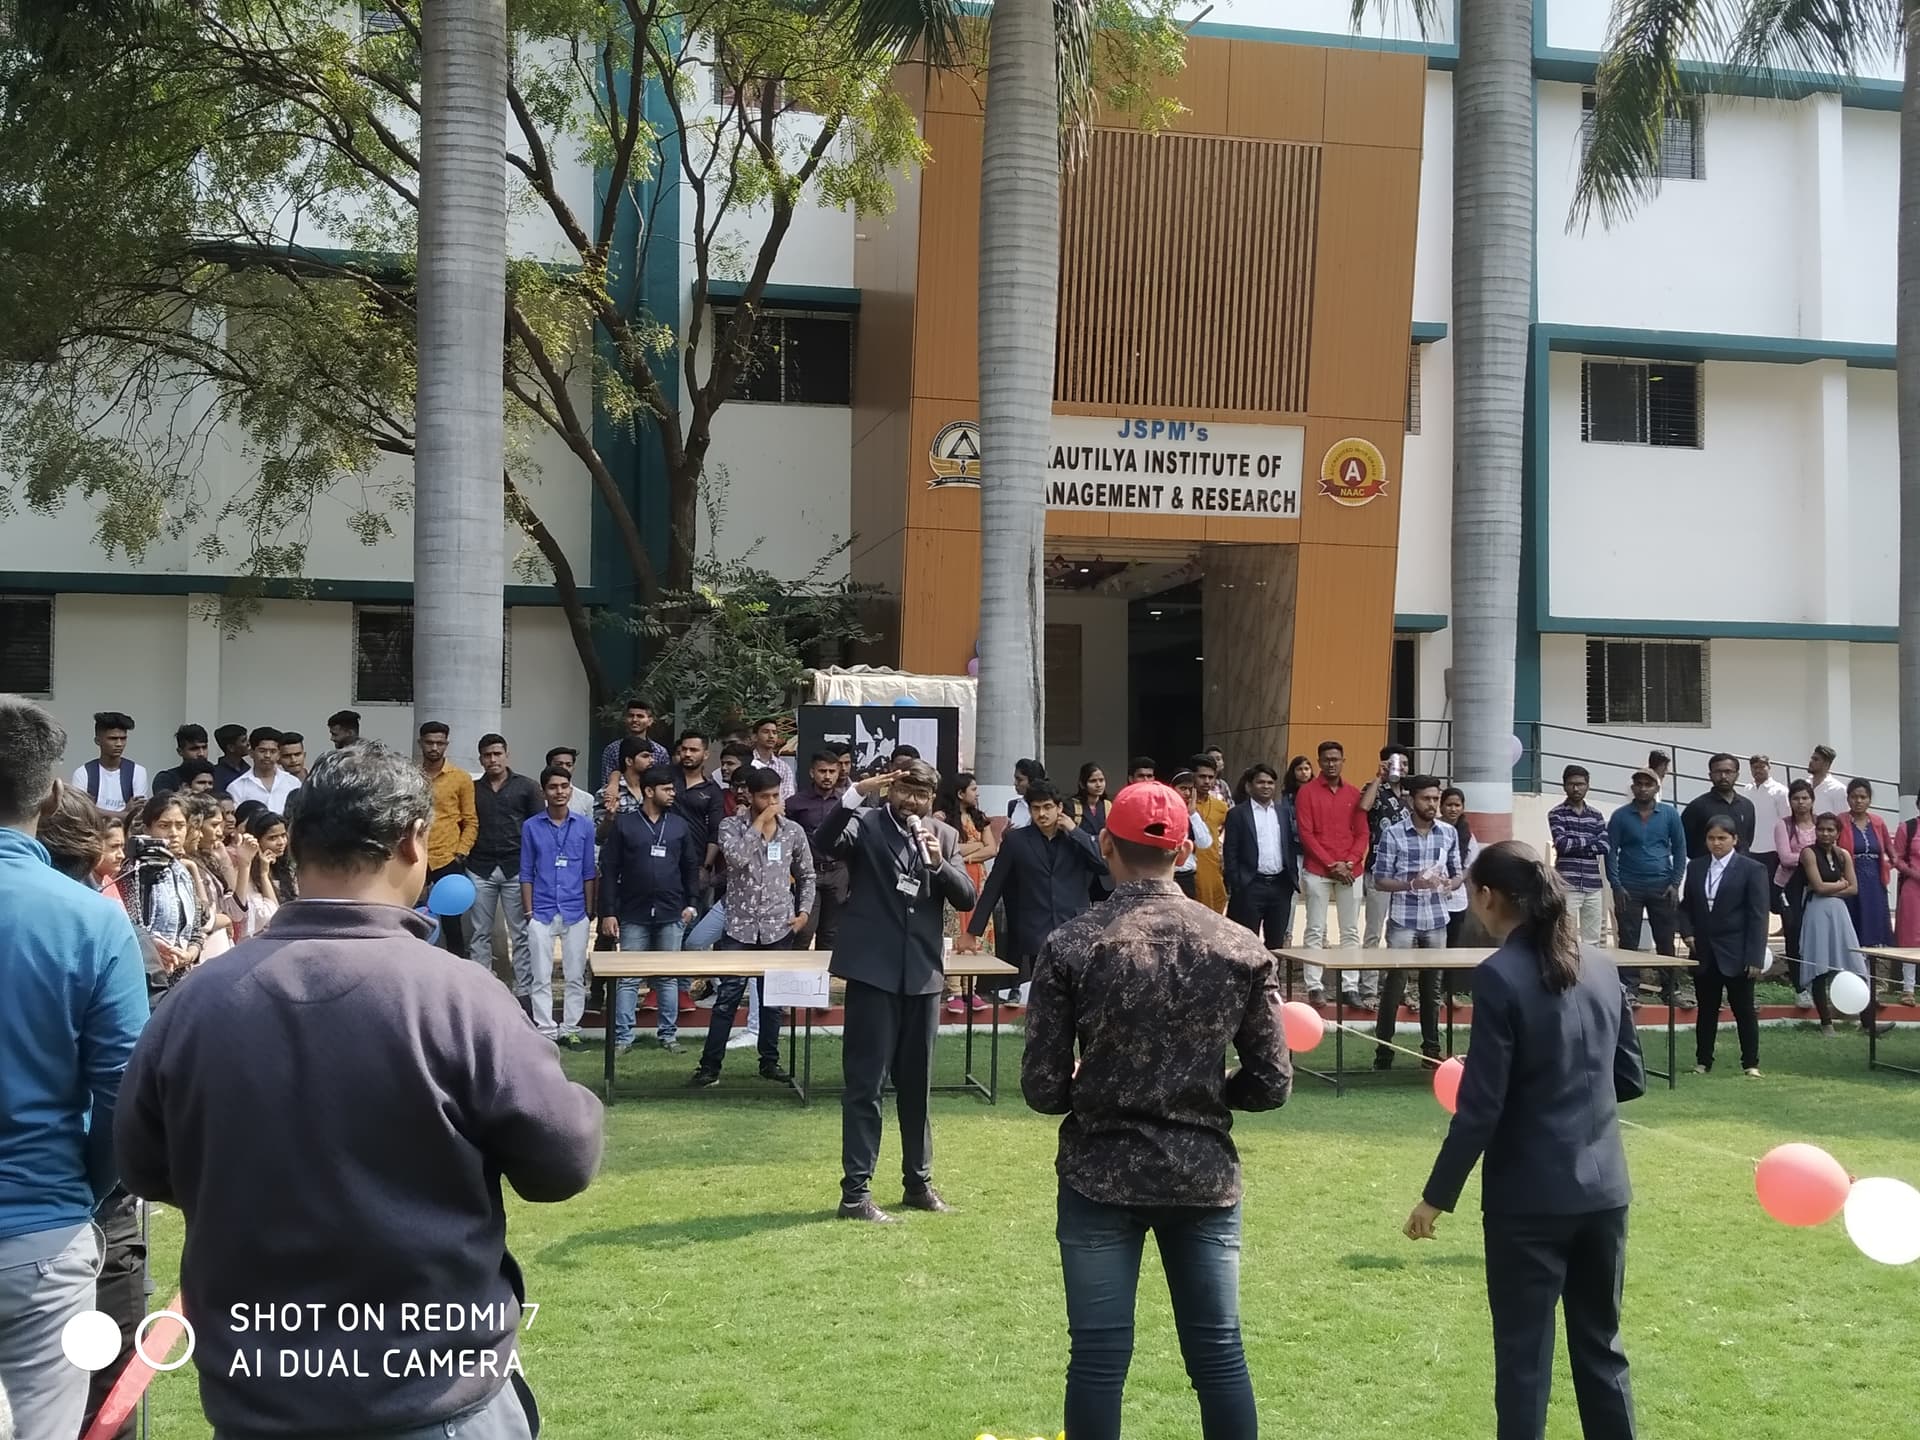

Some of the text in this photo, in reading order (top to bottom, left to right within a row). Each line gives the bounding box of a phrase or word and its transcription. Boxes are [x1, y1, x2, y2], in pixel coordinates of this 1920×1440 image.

[1118, 419, 1208, 442] JSPM's
[1047, 445, 1282, 478] AUTILYA INSTITUTE OF
[1344, 460, 1361, 481] A
[1171, 486, 1184, 509] &
[1192, 487, 1296, 513] RESEARCH
[1340, 488, 1365, 497] NAAC
